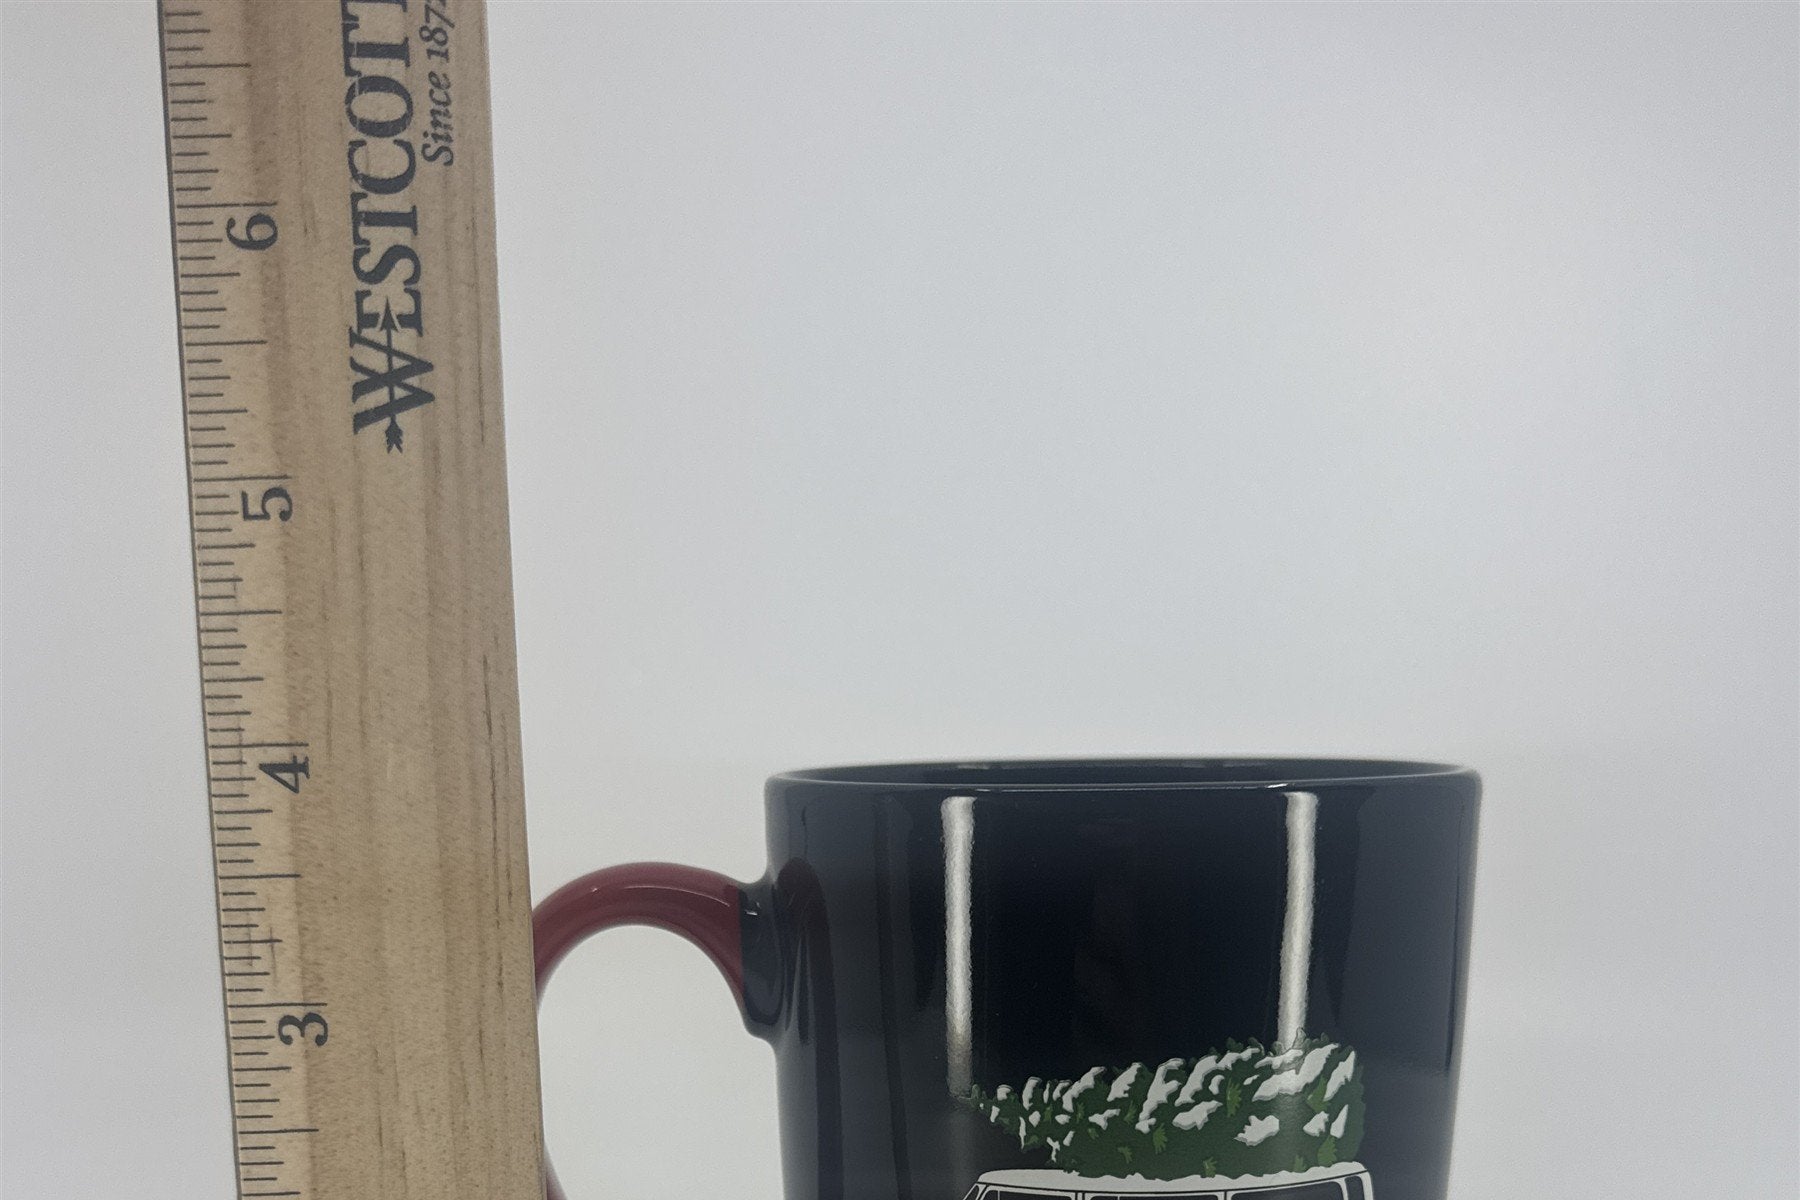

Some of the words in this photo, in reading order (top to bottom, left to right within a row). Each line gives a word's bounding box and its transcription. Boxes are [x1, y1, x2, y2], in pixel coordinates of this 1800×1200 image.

[418, 0, 456, 63] 187
[421, 71, 455, 166] Since
[225, 212, 279, 251] 6
[241, 486, 294, 522] 5
[258, 754, 311, 794] 4
[277, 1011, 330, 1047] 3
